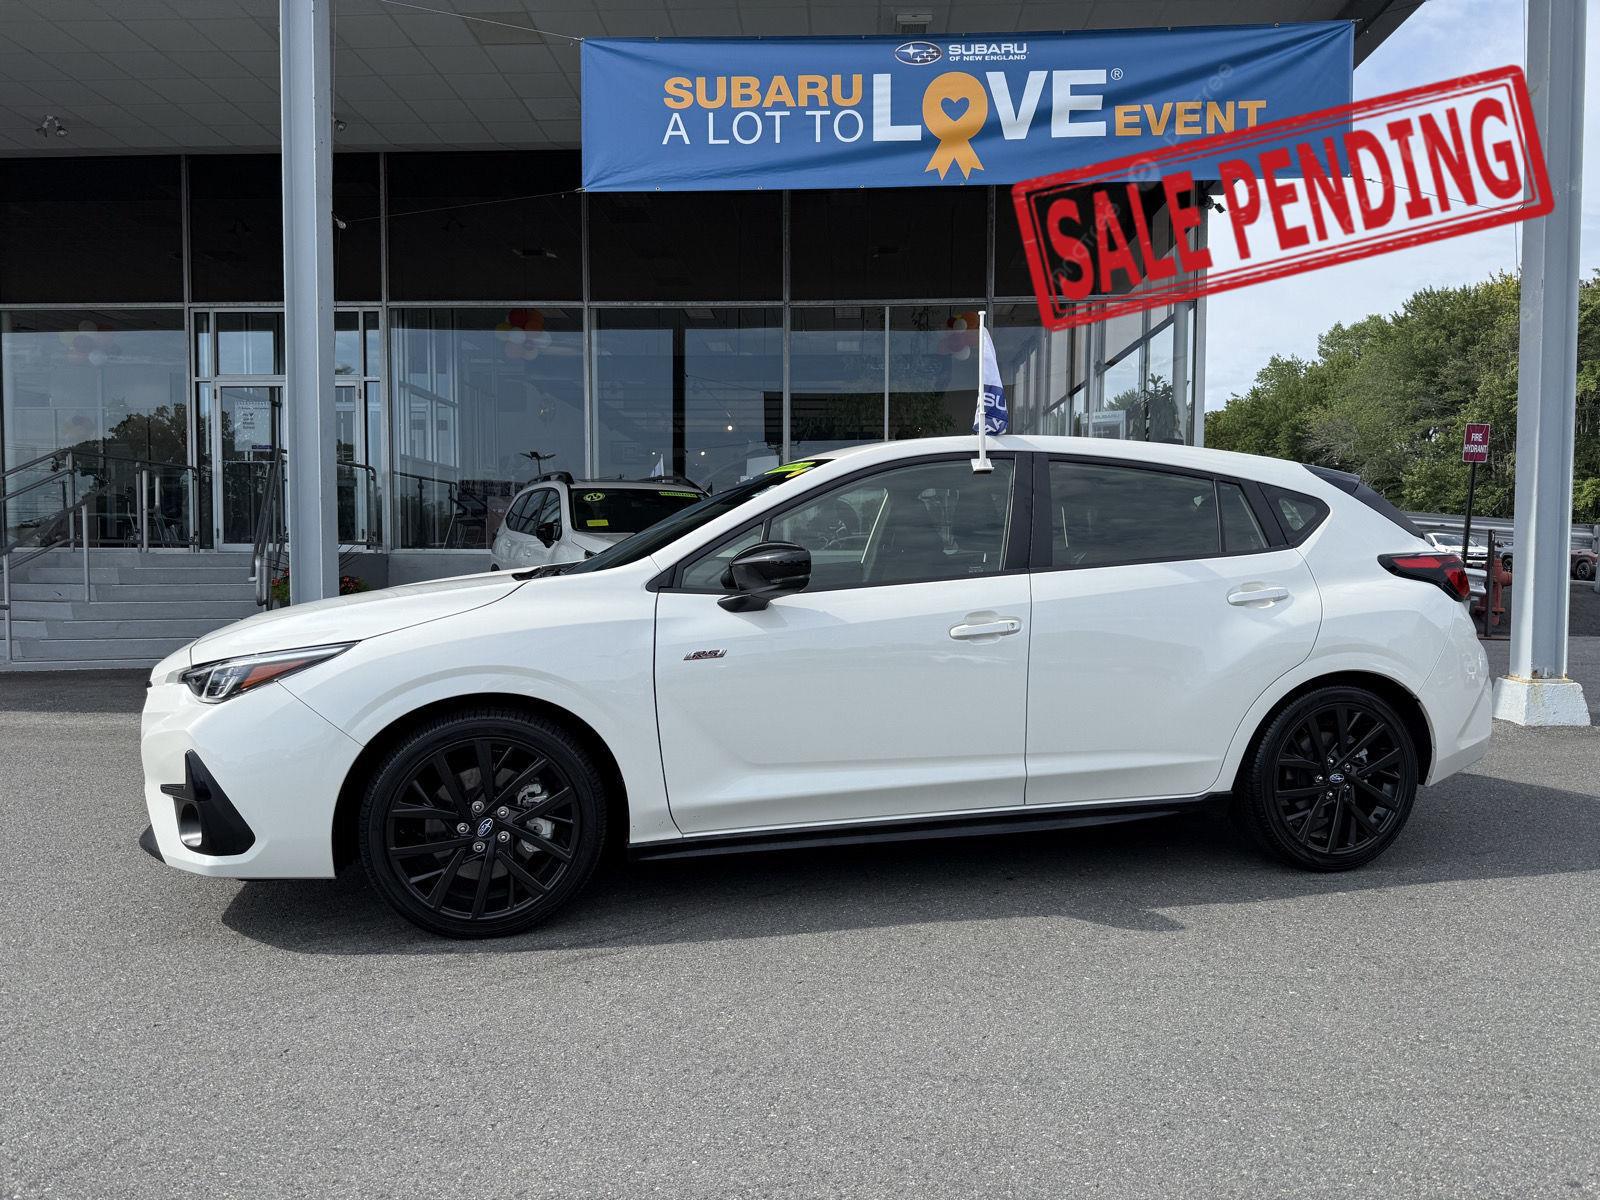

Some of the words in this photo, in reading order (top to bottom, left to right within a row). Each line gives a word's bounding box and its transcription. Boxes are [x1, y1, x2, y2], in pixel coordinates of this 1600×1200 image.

[948, 42, 1027, 54] SUBARU
[663, 74, 863, 109] SUBARU
[661, 112, 691, 145] A
[707, 110, 791, 145] LOT
[805, 109, 864, 143] TO
[1115, 100, 1267, 137] EVENT
[1471, 433, 1483, 442] FIRE
